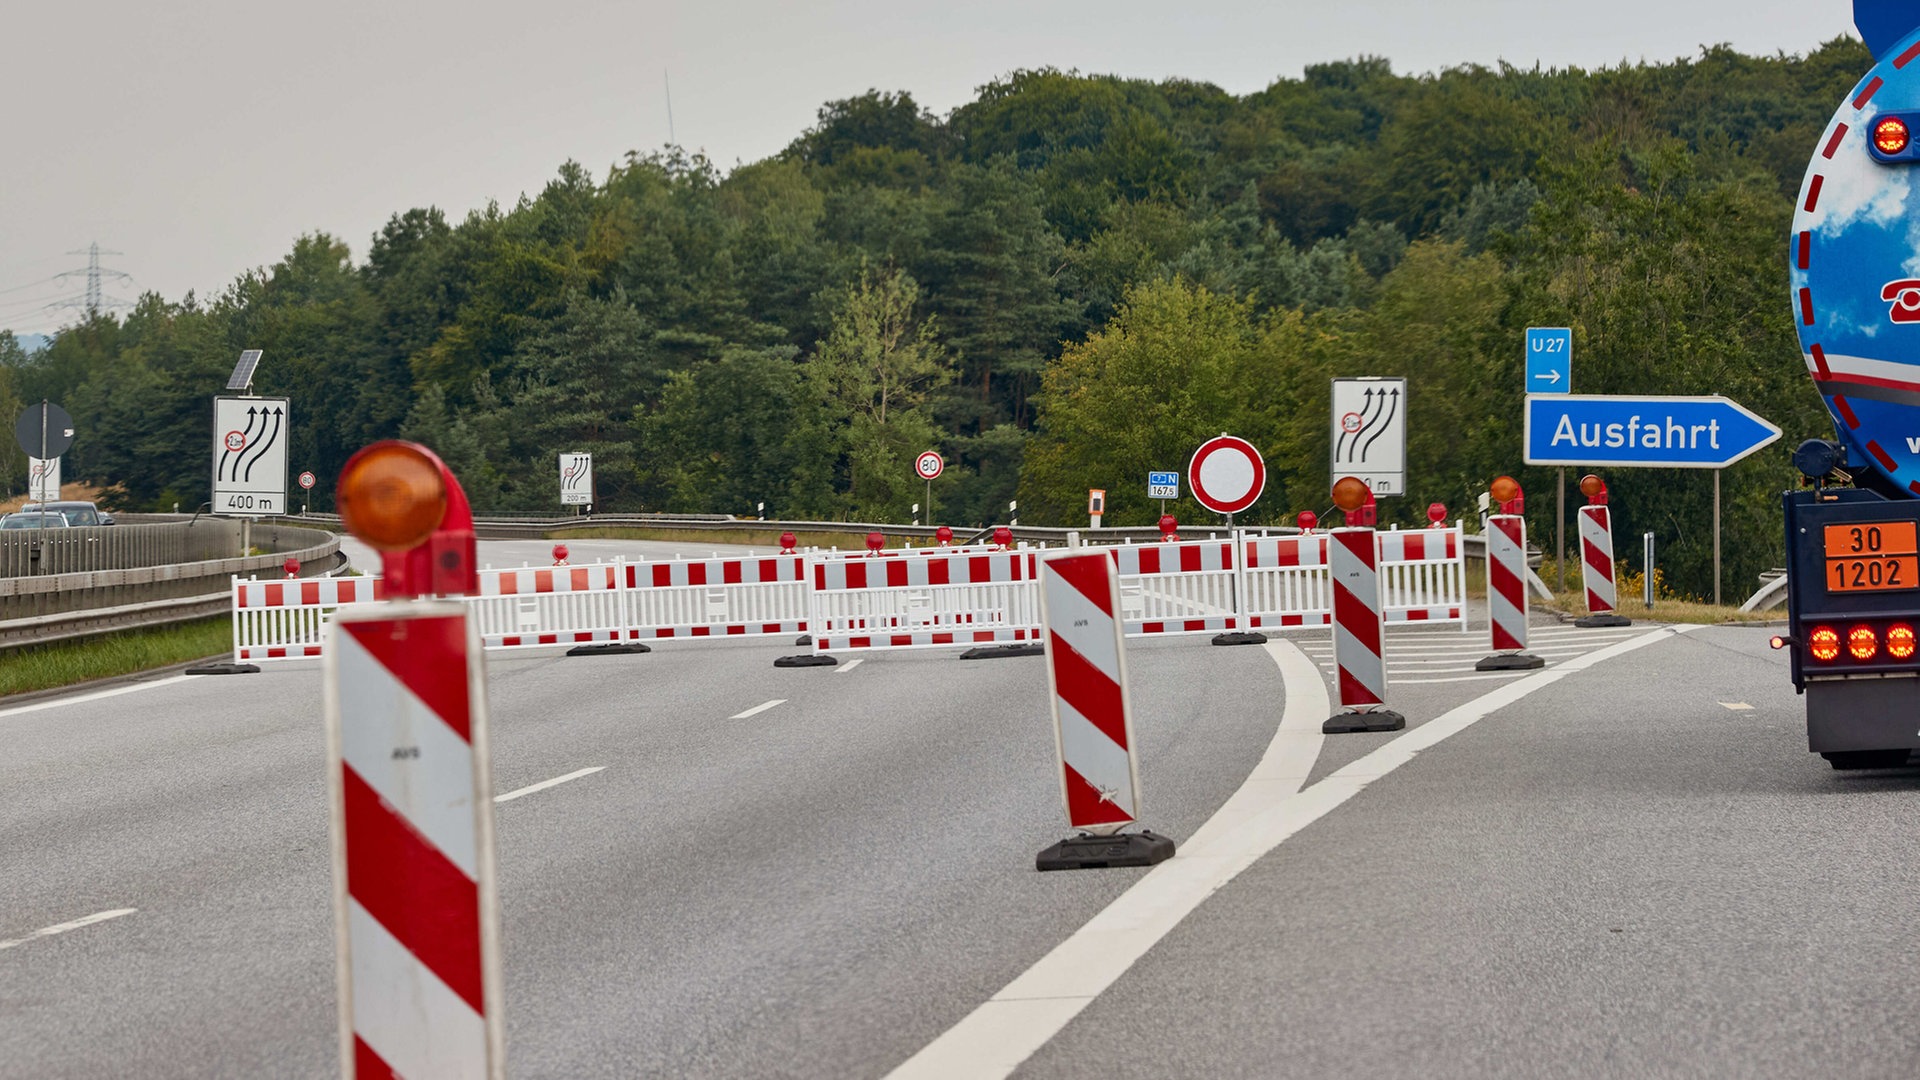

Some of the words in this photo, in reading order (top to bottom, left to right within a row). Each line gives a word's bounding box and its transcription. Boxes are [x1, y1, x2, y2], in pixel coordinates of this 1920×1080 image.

[1550, 413, 1720, 450] Ausfahrt
[922, 459, 937, 471] 80
[1168, 474, 1176, 484] N
[1377, 480, 1391, 492] m
[228, 495, 254, 509] 400
[259, 499, 272, 510] m
[1850, 527, 1881, 552] 30
[1835, 560, 1901, 587] 1202
